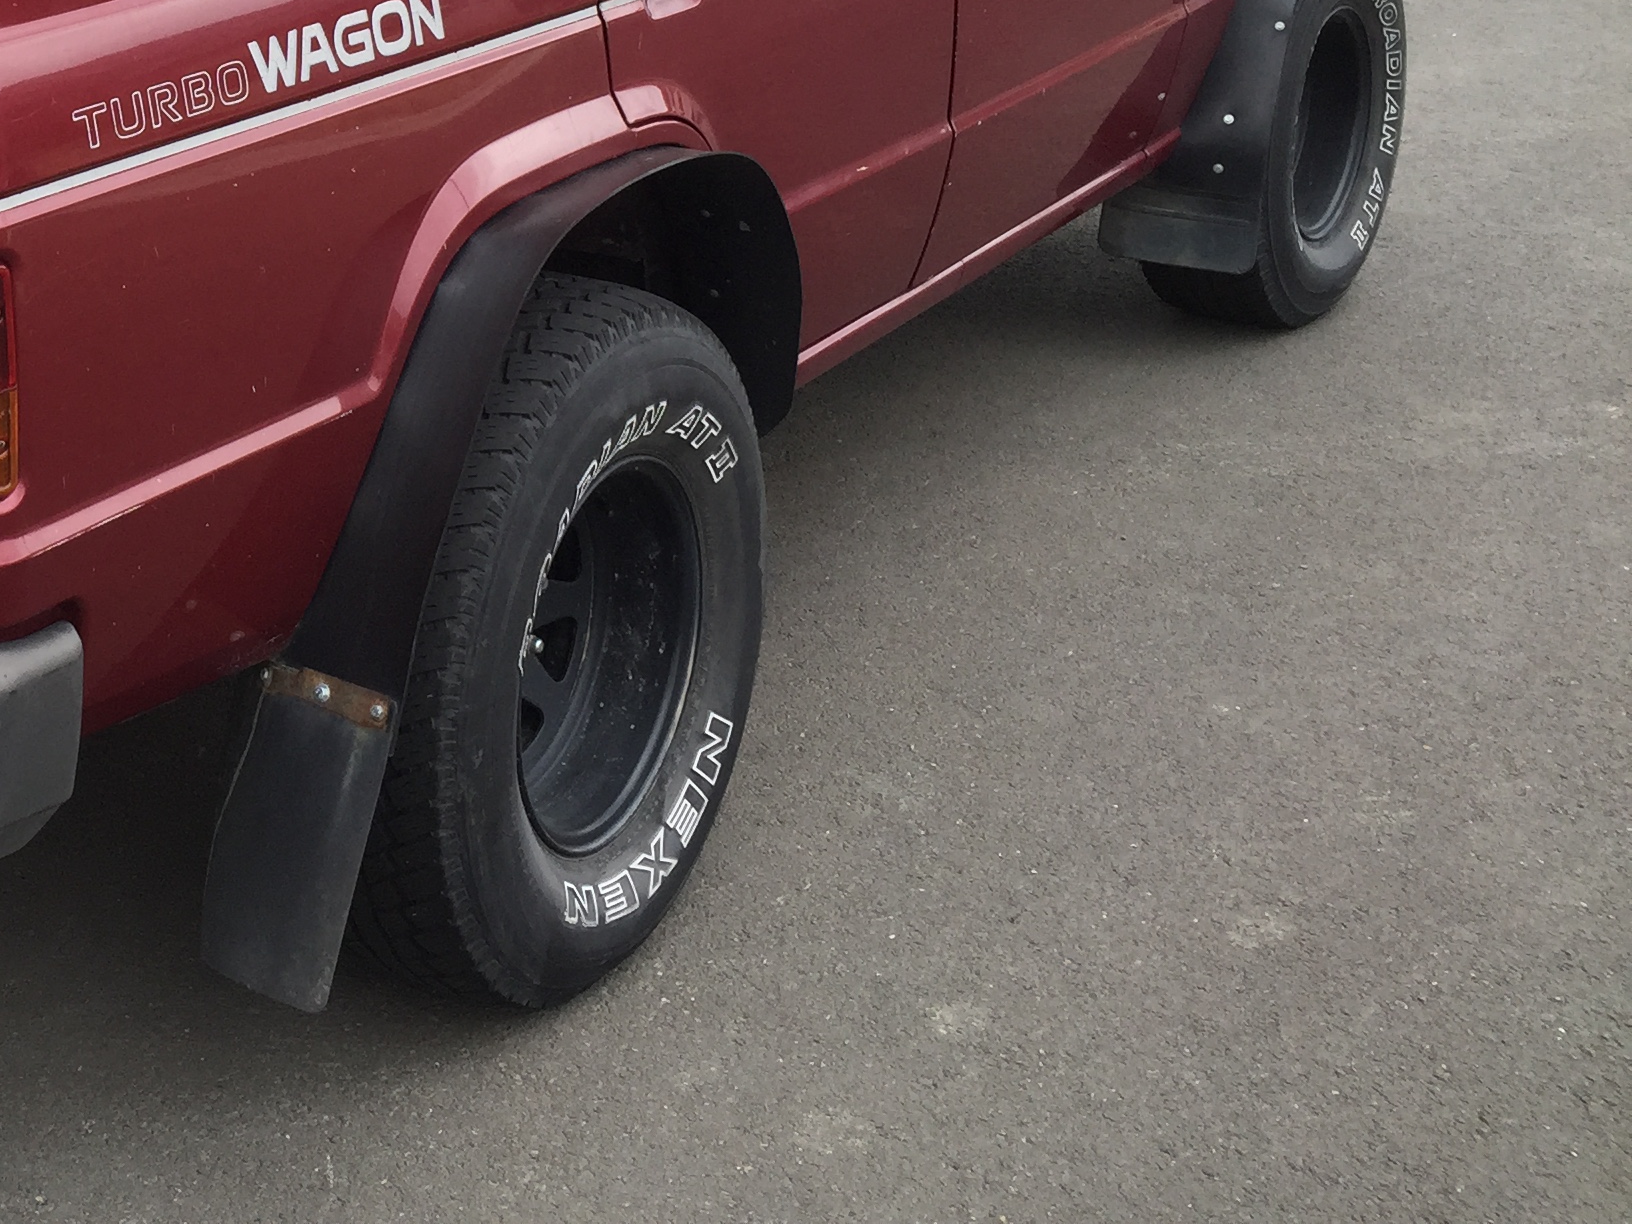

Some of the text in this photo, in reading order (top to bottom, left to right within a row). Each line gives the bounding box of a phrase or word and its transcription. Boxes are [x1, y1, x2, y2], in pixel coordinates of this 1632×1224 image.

[72, 60, 250, 149] TURBO
[1363, 167, 1385, 227] AT
[665, 405, 722, 449] AT
[563, 710, 734, 927] NEXEN
